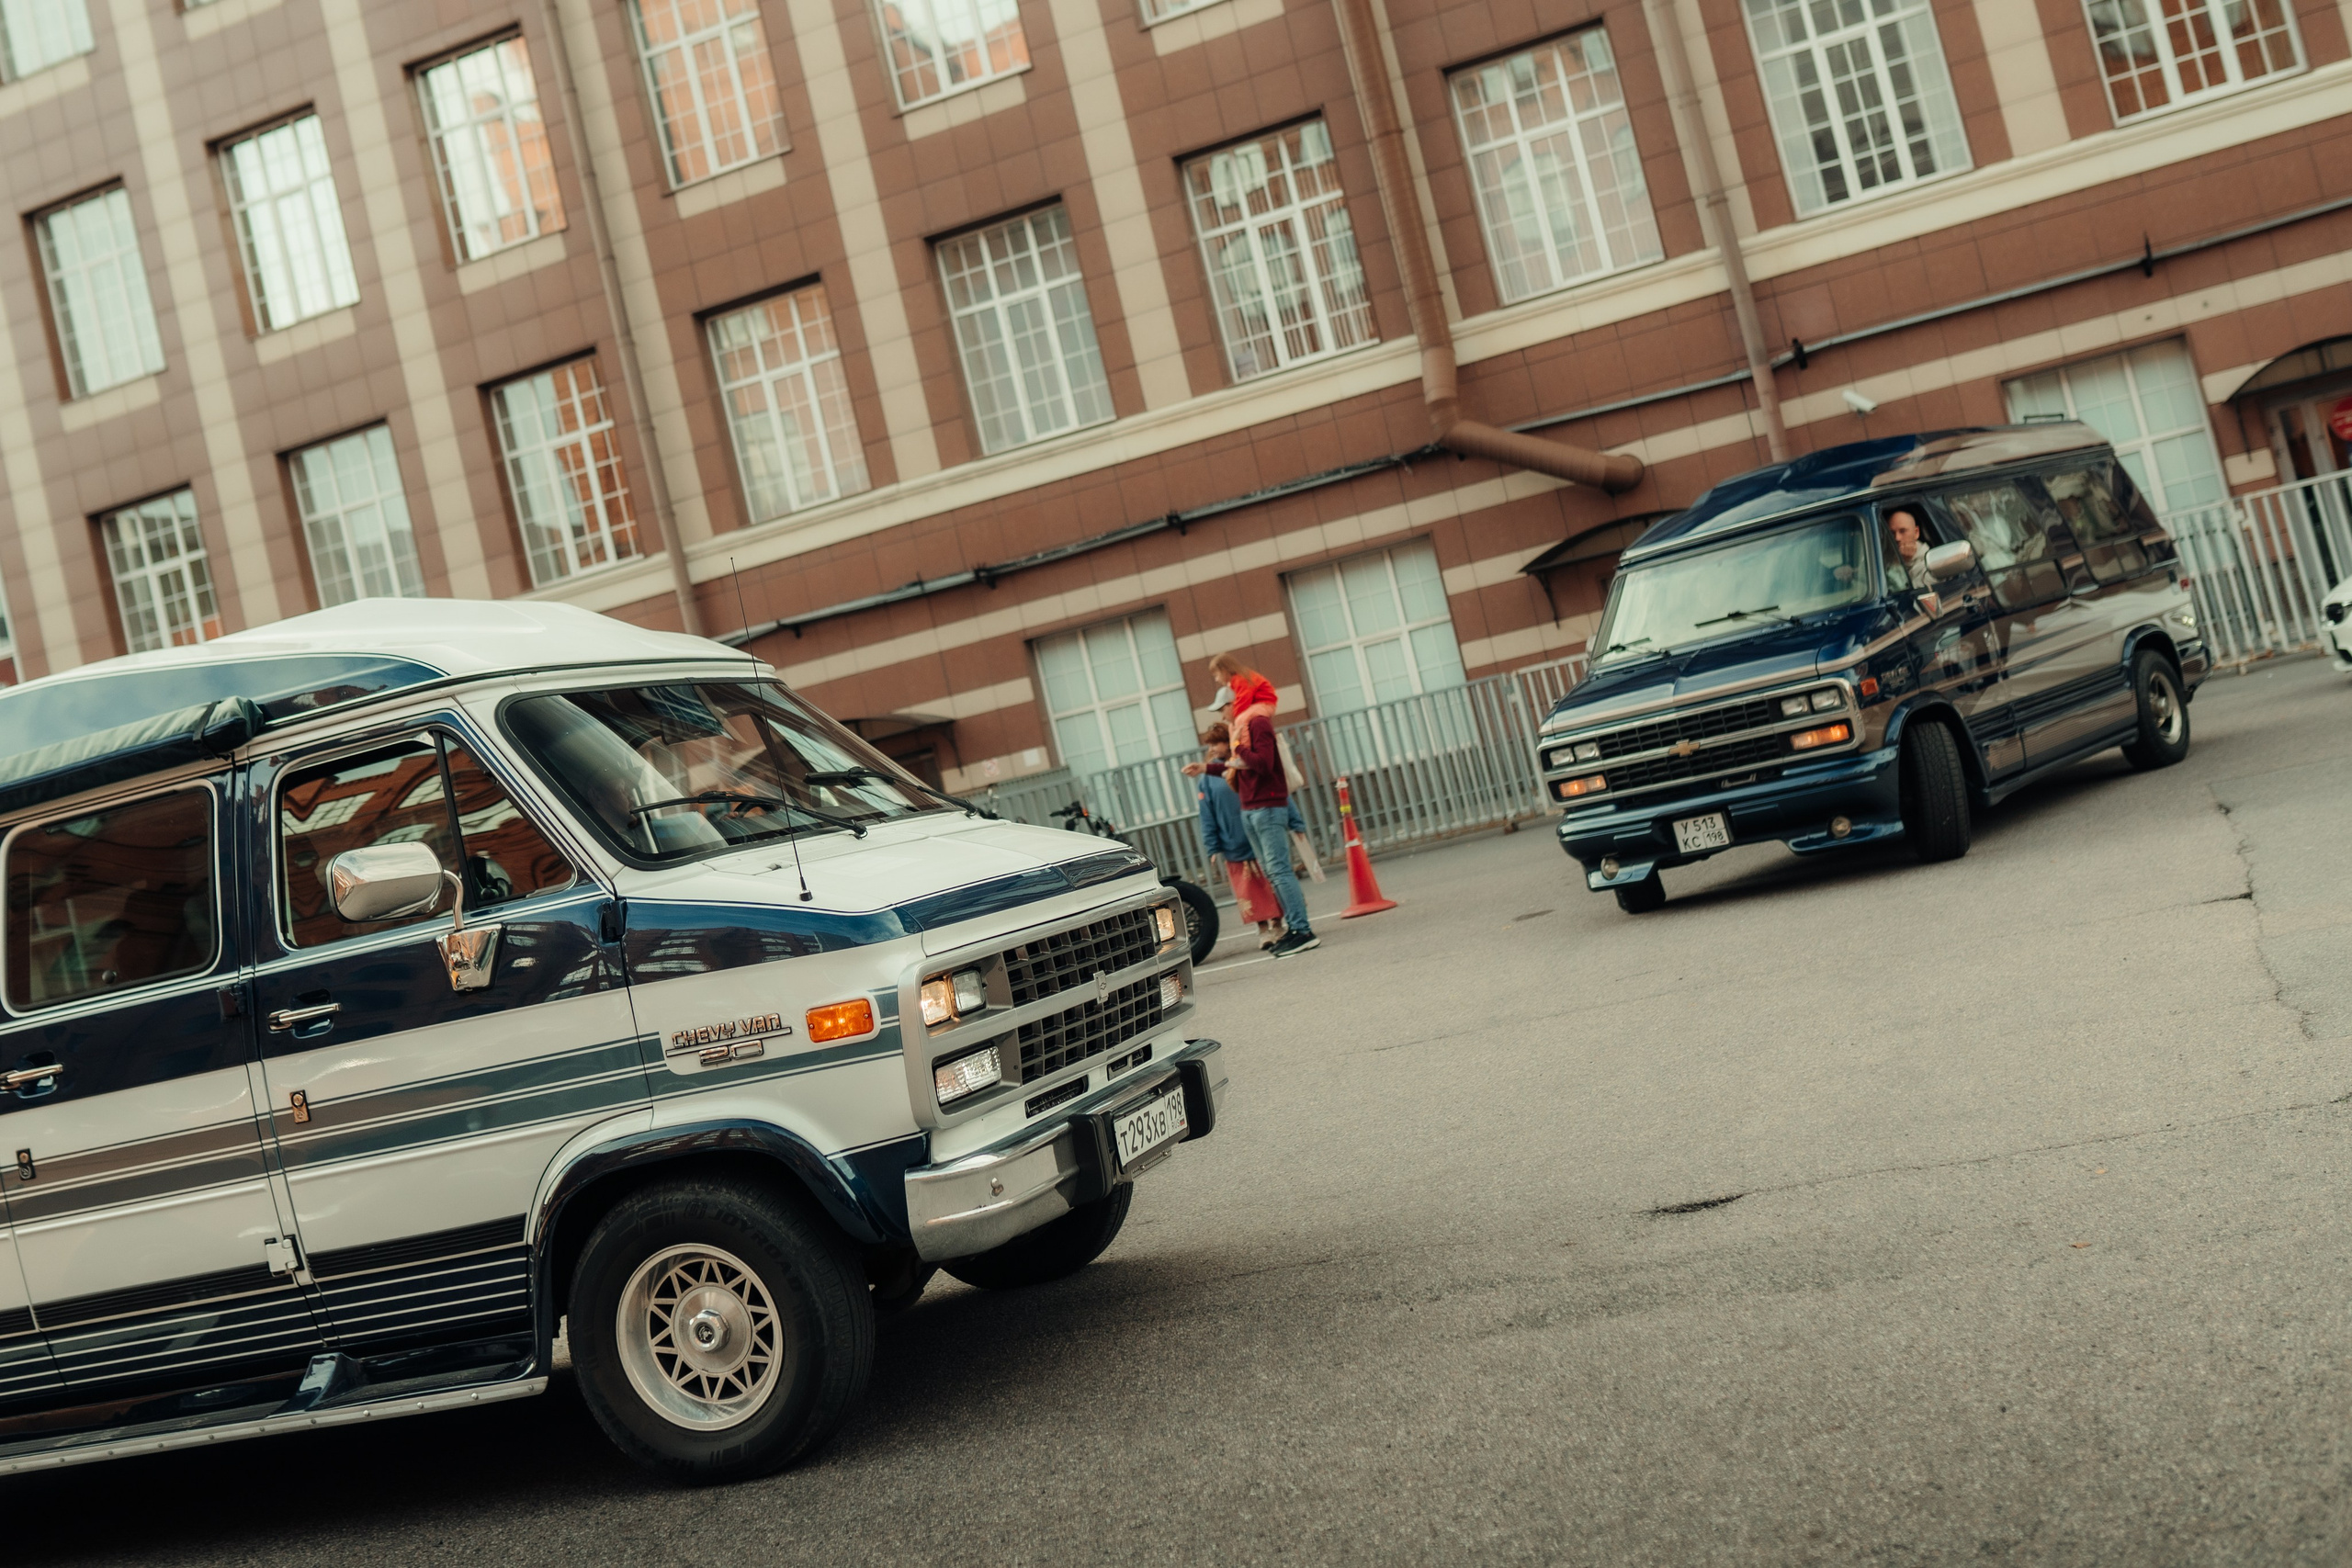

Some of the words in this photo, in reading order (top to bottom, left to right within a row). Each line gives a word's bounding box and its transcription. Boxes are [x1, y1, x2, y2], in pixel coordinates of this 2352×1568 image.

[1692, 816, 1716, 832] 513
[1706, 830, 1724, 842] 198
[671, 1021, 736, 1049] CHEVY
[738, 1012, 783, 1035] VAN
[698, 1039, 764, 1067] 20
[1167, 1091, 1182, 1121] 198
